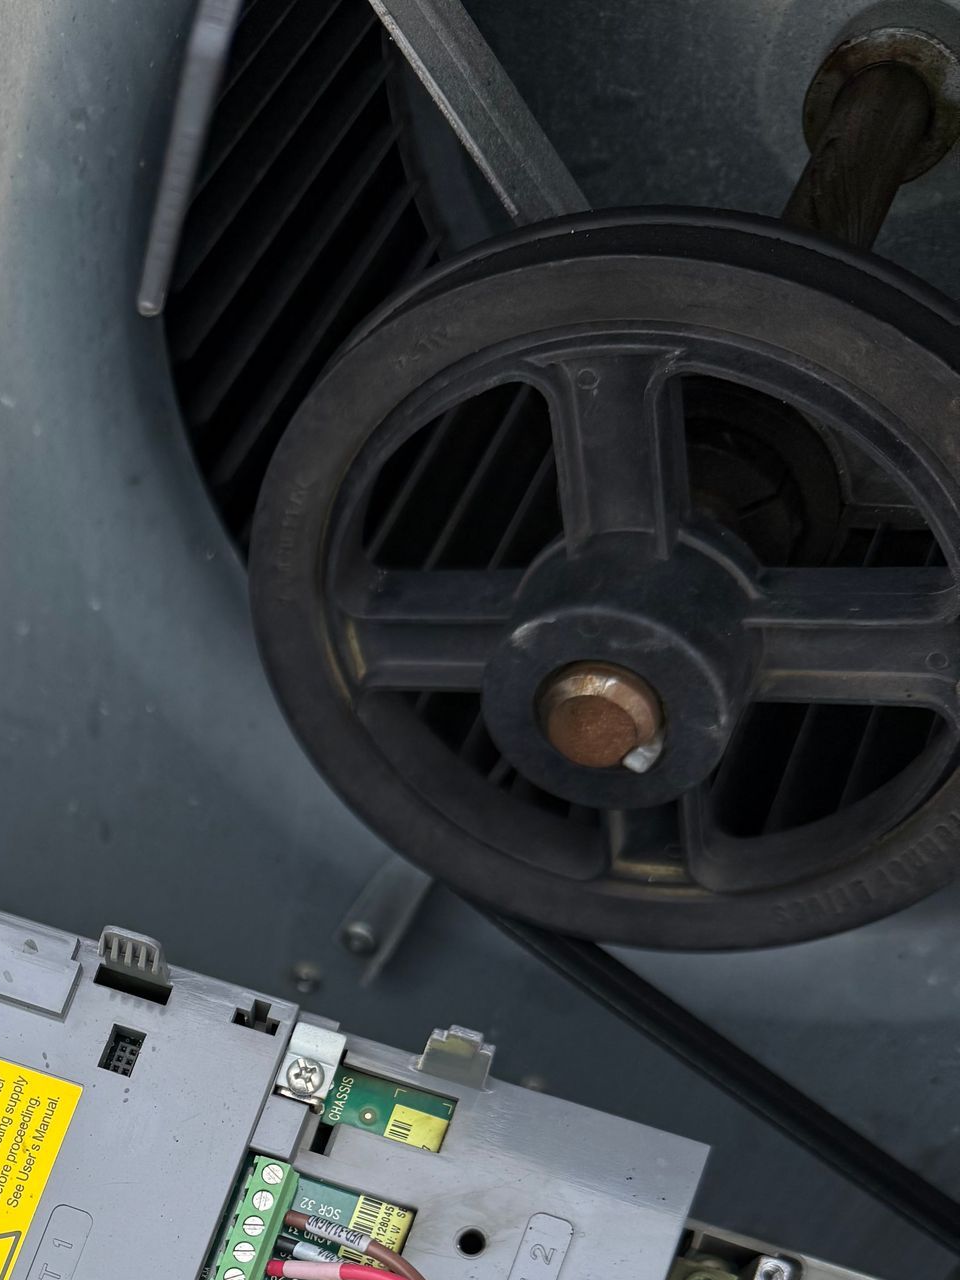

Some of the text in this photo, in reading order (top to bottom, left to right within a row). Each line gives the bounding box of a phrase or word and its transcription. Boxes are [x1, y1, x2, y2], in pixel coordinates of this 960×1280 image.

[5, 1075, 29, 1114] supply
[328, 1076, 354, 1121] CHASSIS
[8, 1095, 41, 1164] proceeding.
[6, 1183, 26, 1208] See
[32, 1096, 60, 1145] Manual.
[300, 1197, 342, 1220] SCR 32
[52, 1238, 74, 1249] 1
[529, 1243, 557, 1266] 2
